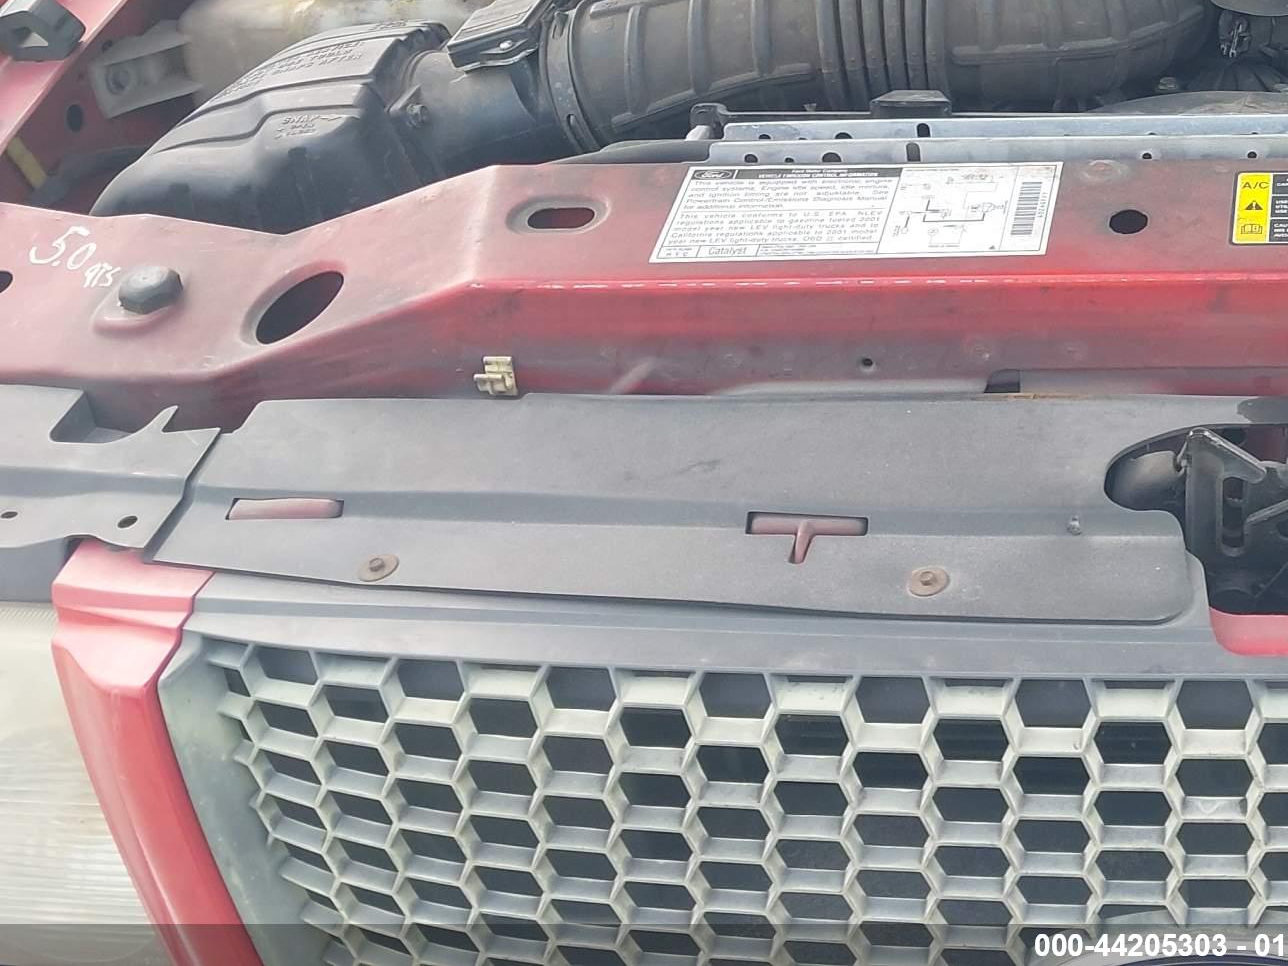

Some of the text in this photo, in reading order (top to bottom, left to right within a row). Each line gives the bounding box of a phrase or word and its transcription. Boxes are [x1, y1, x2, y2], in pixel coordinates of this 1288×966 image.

[1242, 182, 1270, 190] A/C
[29, 225, 98, 271] 5.0
[708, 247, 748, 256] Catalyst
